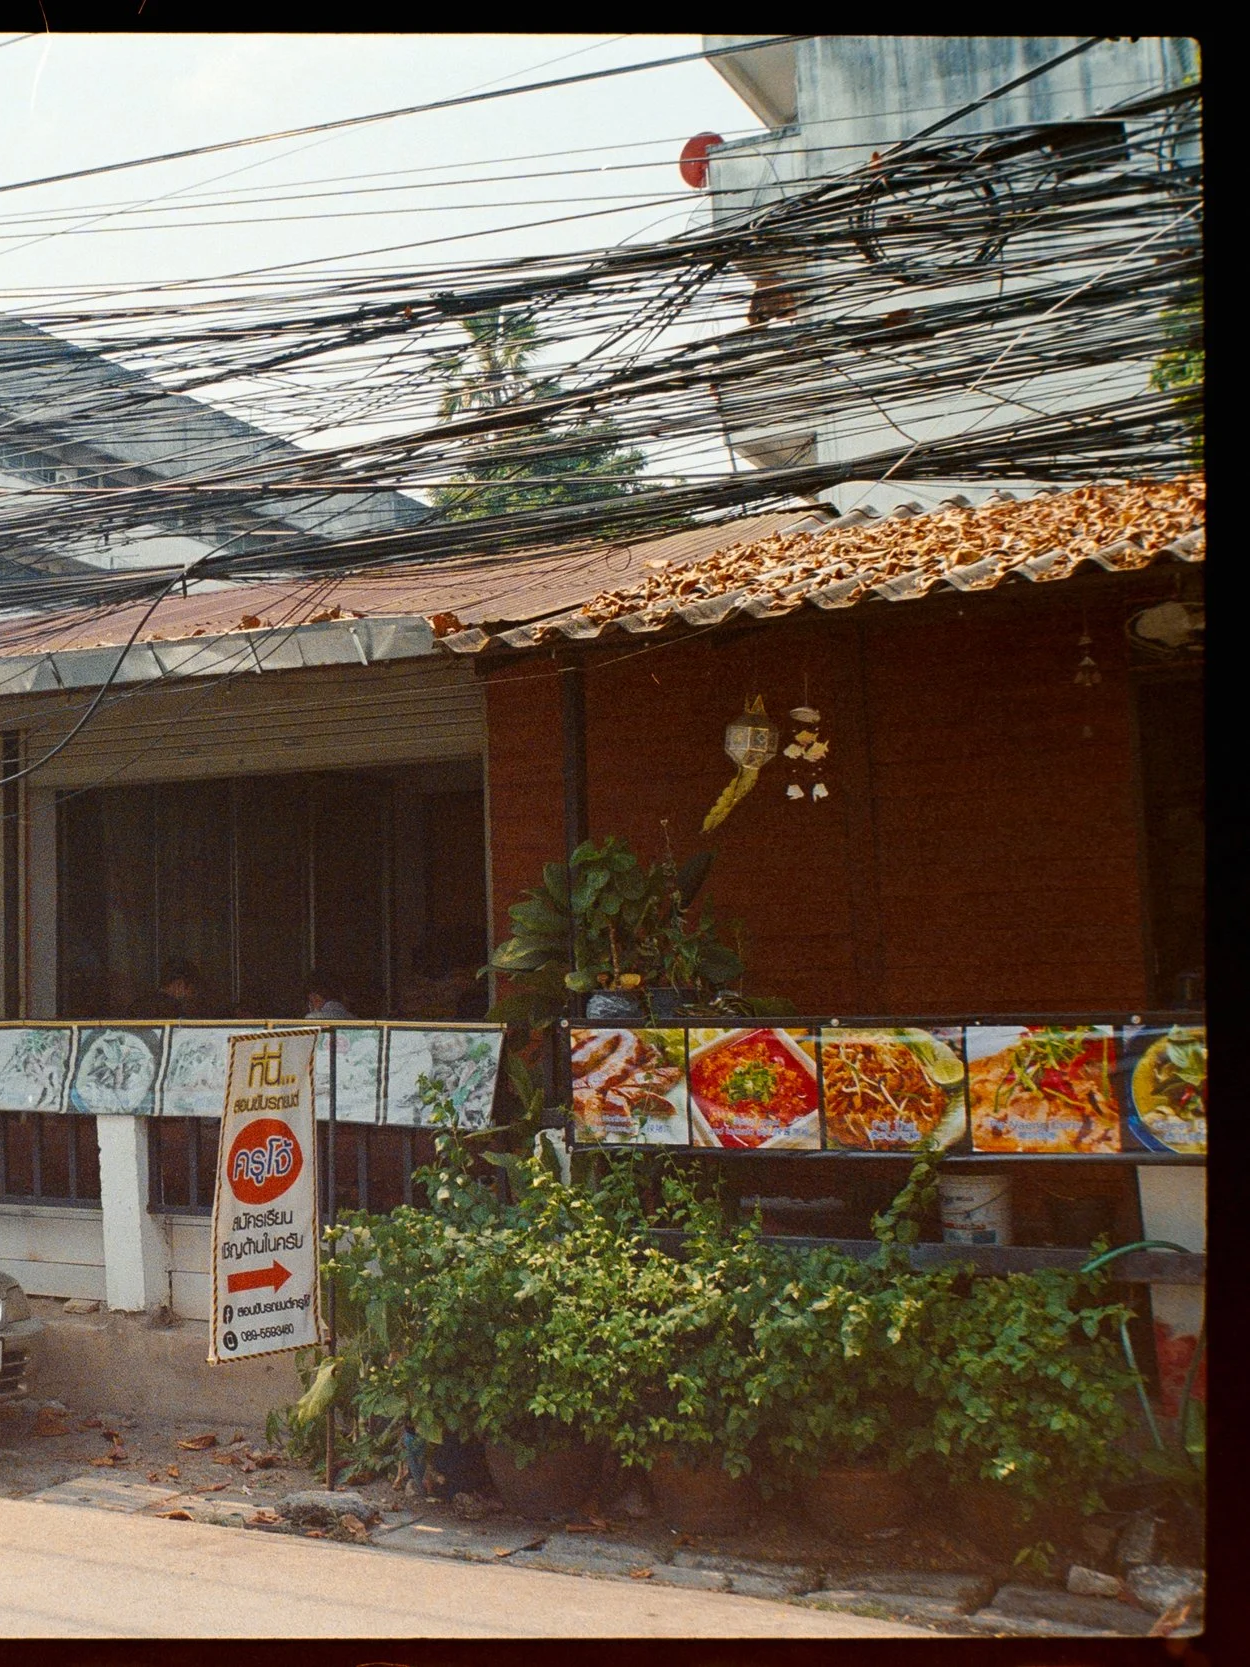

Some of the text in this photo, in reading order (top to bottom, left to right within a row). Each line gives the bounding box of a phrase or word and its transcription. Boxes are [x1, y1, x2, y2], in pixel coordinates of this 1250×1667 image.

[233, 1135, 293, 1186] ครูโจ้
[232, 1208, 293, 1231] สมัครเรียน
[221, 1232, 304, 1260] เชิญด้านในครับ
